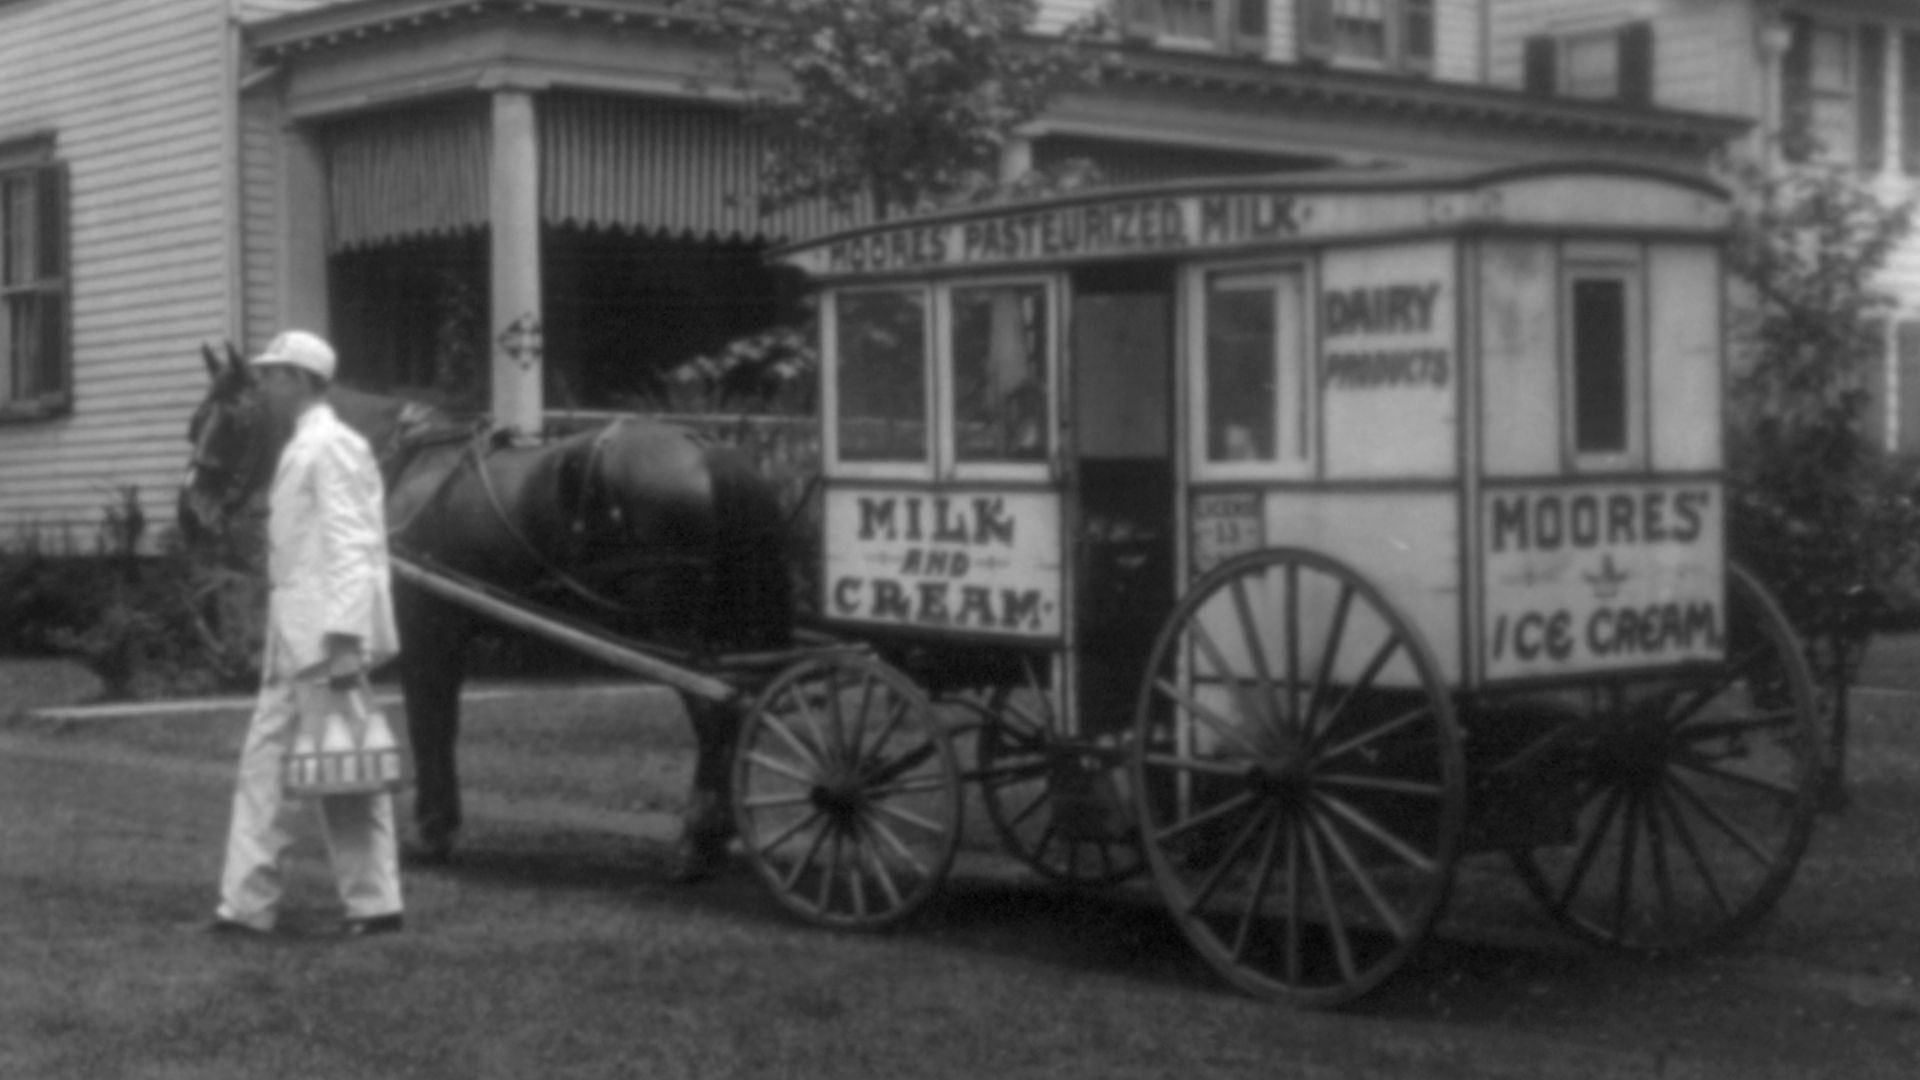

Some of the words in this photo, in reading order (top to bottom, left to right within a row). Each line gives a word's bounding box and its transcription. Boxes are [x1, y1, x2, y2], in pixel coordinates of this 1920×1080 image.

[1324, 281, 1441, 337] DAIRY
[1323, 348, 1450, 390] PRODUCTS
[857, 497, 1014, 549] MILK
[901, 548, 971, 578] AND
[1493, 608, 1575, 662] ICE
